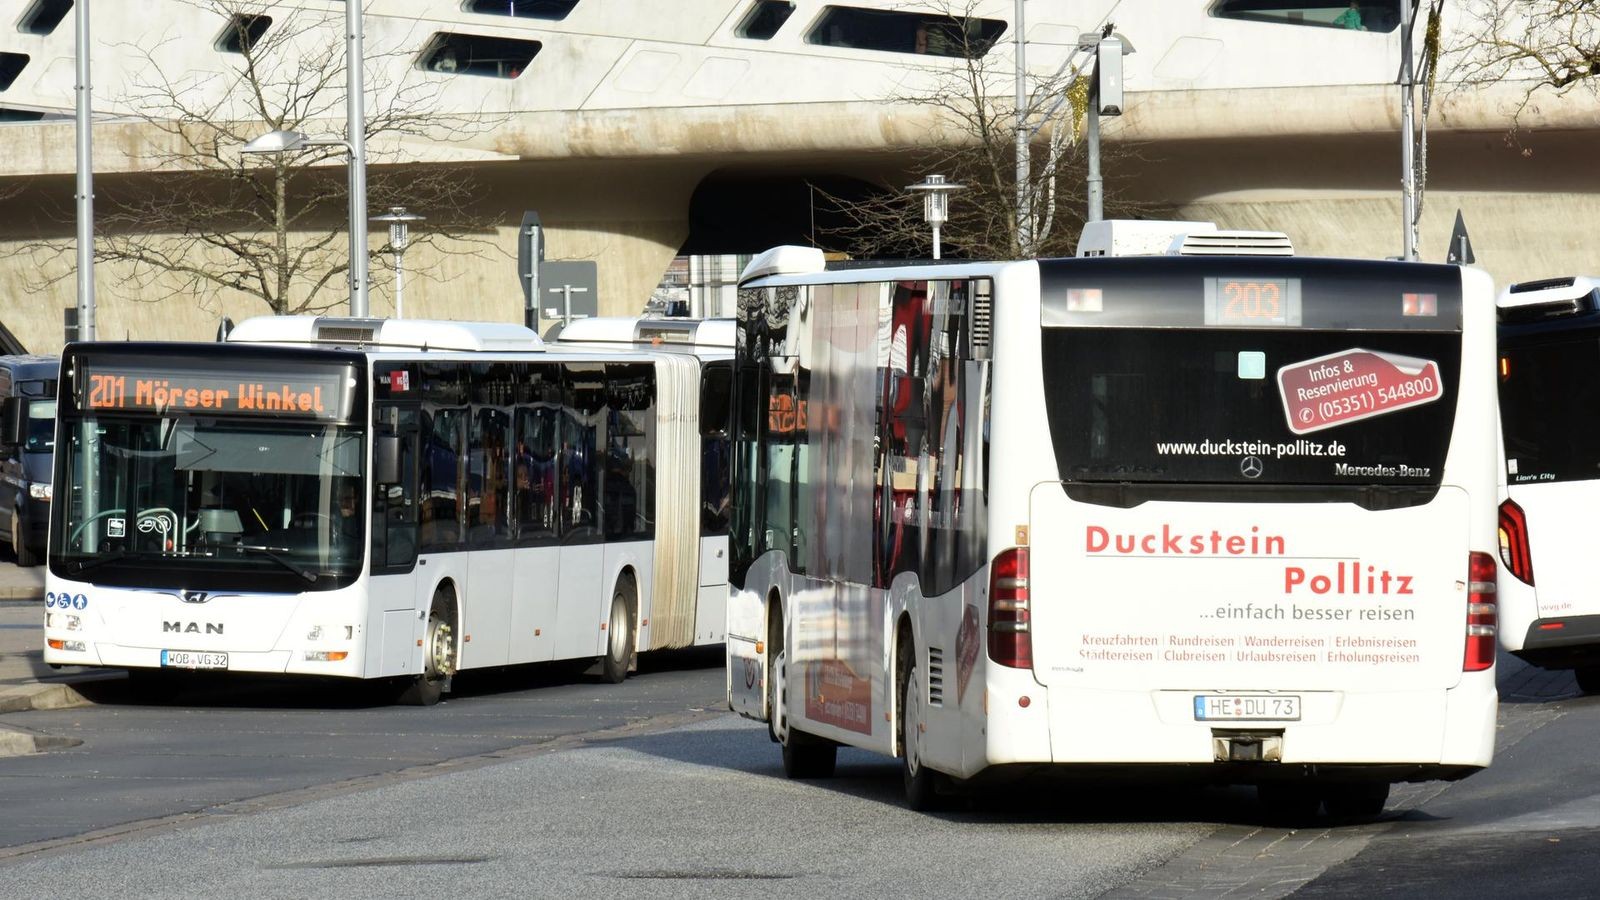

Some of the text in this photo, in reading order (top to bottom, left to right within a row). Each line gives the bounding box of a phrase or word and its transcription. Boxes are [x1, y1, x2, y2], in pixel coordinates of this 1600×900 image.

[1223, 282, 1280, 319] 203
[1309, 359, 1354, 382] Infos &
[89, 375, 324, 413] 201 Mörser Winkel
[1297, 372, 1378, 401] Reservierung
[1319, 376, 1434, 421] (05351) 544800
[1157, 439, 1347, 459] www.duckstein-pollitz.de
[1334, 463, 1431, 478] Mercedes-Benz
[1086, 524, 1285, 555] Duckstein
[1284, 562, 1414, 594] Pollitz
[1199, 603, 1415, 622] ...einfach besser reisen
[163, 621, 223, 634] MAN
[1082, 634, 1417, 648] Kreuzfahrten Rundreisen Wanderreisen Erlebnisreisen
[169, 653, 226, 666] WOB VG 32
[1079, 649, 1420, 665] Städtereisen Clubreisen Urlaubsreisen Erholungsreisen
[1211, 699, 1232, 715] HE
[1245, 699, 1266, 715] DU
[1272, 699, 1293, 715] 73
